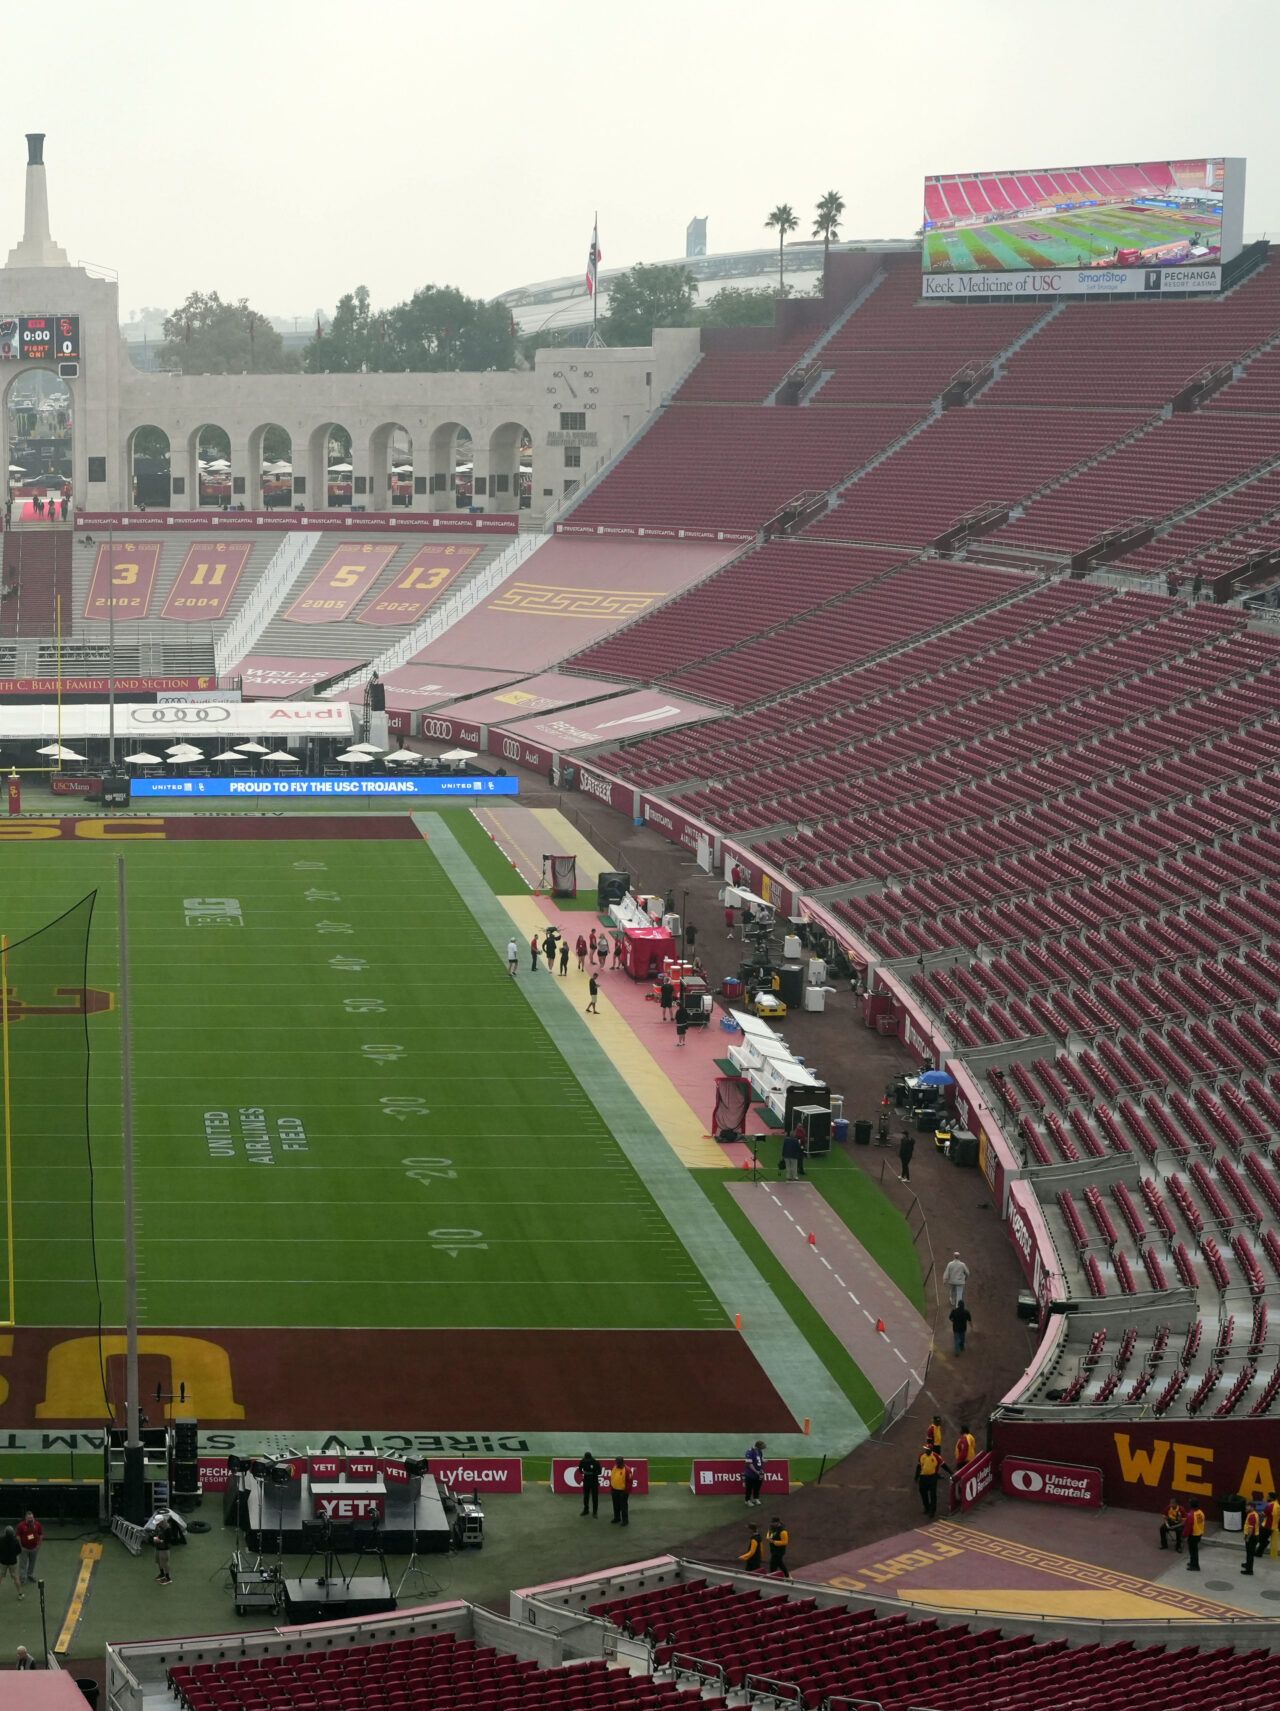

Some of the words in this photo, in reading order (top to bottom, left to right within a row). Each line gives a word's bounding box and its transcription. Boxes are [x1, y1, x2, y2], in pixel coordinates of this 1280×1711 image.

[1078, 272, 1127, 284] SmartStop
[1164, 271, 1217, 281] PECHANGA
[925, 277, 955, 294] Keck
[958, 276, 1013, 293] Medicine
[1015, 275, 1031, 292] of
[1032, 275, 1061, 291] USC
[24, 331, 50, 341] 0:00
[63, 341, 72, 353] 0
[112, 563, 139, 585] 3
[189, 563, 223, 585] 11
[329, 565, 368, 587] 5
[398, 567, 452, 589] 13
[95, 597, 141, 606] 2002
[174, 597, 219, 607] 2004
[301, 600, 347, 609] 2005
[375, 601, 421, 611] 2022
[246, 668, 330, 678] WELLS
[67, 679, 105, 690] FAMILY
[142, 679, 190, 689] SECTION
[269, 708, 343, 719] Audi
[459, 728, 479, 743] Audi
[525, 750, 539, 765] Audi
[229, 782, 272, 793] PROUD
[273, 782, 288, 792] TO
[290, 782, 309, 792] FLY
[311, 782, 332, 792] THE
[334, 782, 359, 792] USC
[361, 781, 418, 792] TROJANS.
[579, 768, 612, 805] SEATGEEK
[342, 998, 387, 1012] 50
[361, 1044, 408, 1060] 40
[379, 1096, 430, 1115] 30
[204, 1111, 235, 1156] UNITED
[239, 1108, 275, 1164] AIRLINES
[277, 1117, 309, 1150] FIELD
[401, 1157, 458, 1179] 20
[427, 1228, 489, 1250] 10
[322, 1434, 530, 1452] DIRECTV
[313, 1463, 336, 1472] YETI
[351, 1464, 374, 1473] YETI
[977, 1461, 991, 1481] United
[1114, 1432, 1214, 1496] WE
[386, 1467, 407, 1479] YETI
[440, 1469, 508, 1486] LyfeLaw
[977, 1472, 993, 1493] Rentals
[1045, 1474, 1089, 1488] United
[1045, 1485, 1091, 1499] Rentals
[321, 1499, 376, 1517] YETI
[858, 1541, 965, 1583] FIGHT
